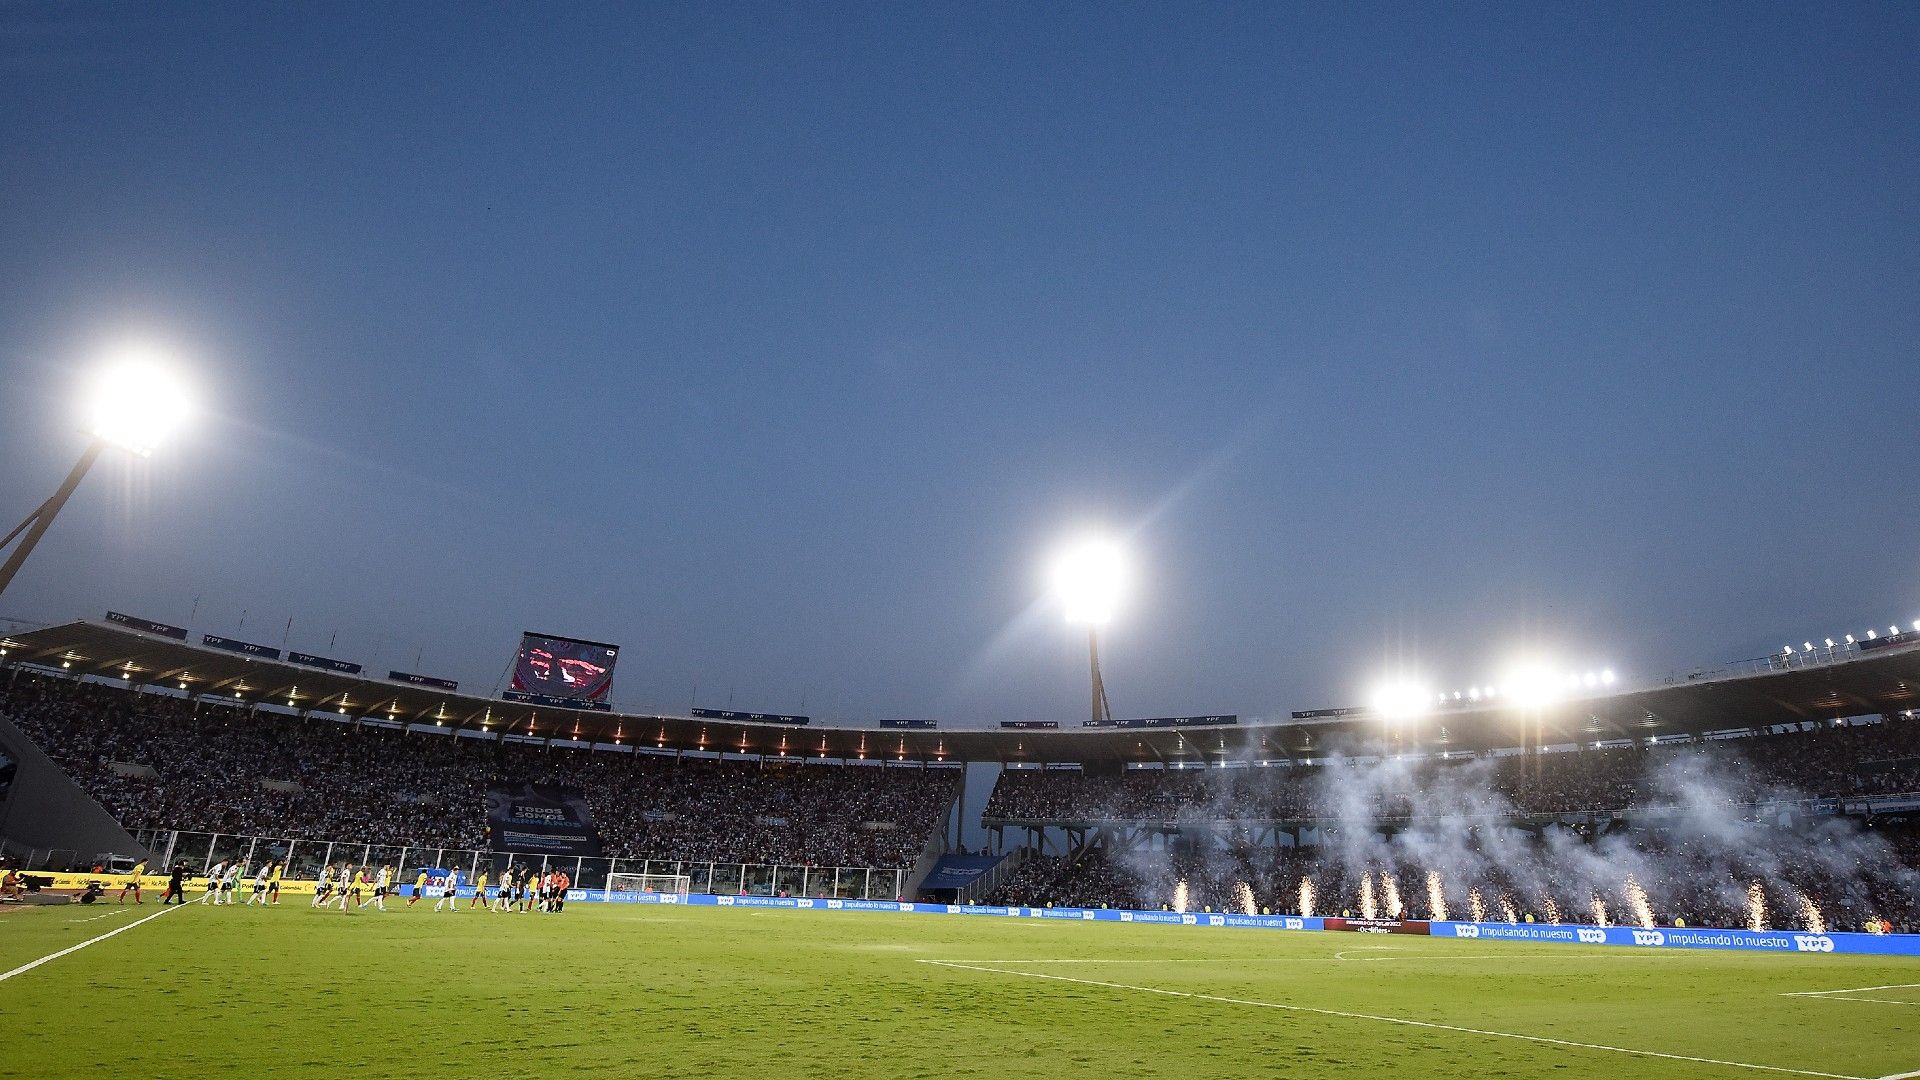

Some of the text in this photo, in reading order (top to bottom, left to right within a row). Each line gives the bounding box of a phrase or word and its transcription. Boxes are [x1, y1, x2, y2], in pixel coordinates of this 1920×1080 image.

[110, 613, 168, 633] YPF YPF
[205, 636, 261, 652] YPF YPF
[298, 654, 351, 670] YPF YPF
[515, 805, 563, 814] TODOS
[515, 812, 566, 821] SOMOS
[1226, 917, 1256, 926] Impulsando
[1482, 926, 1529, 938] Impulsando
[1530, 928, 1538, 937] lo
[1541, 929, 1573, 939] nuestro
[1669, 934, 1730, 945] Impulsando
[1732, 934, 1743, 946] lo
[1746, 937, 1789, 948] nuestro
